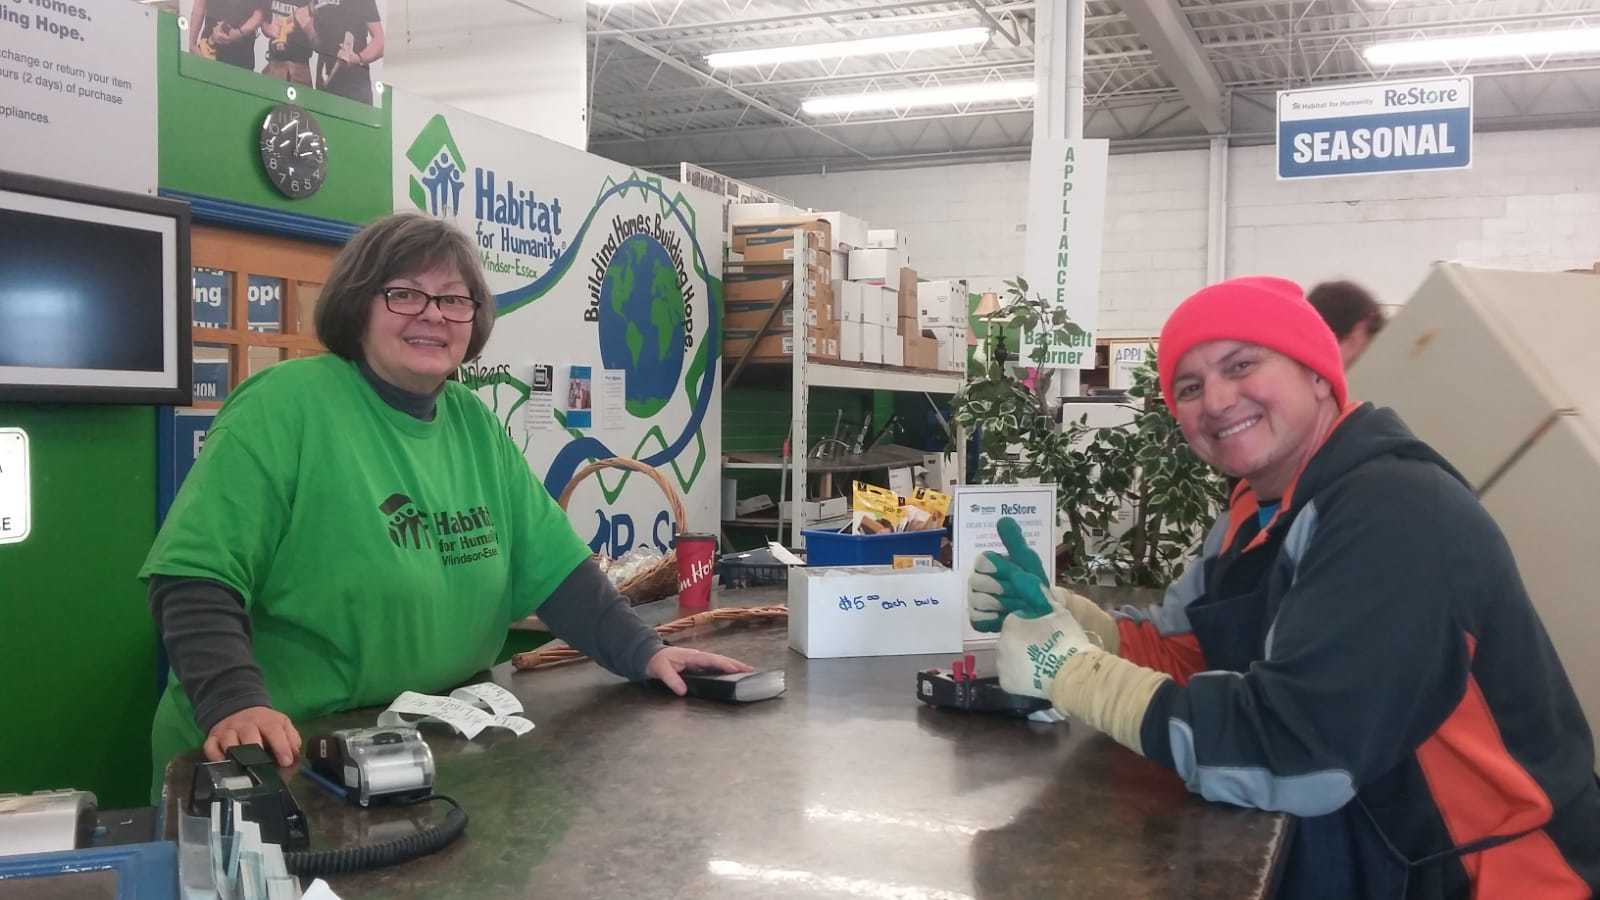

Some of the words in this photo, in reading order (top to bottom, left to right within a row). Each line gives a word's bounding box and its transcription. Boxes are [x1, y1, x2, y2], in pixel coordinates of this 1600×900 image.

[0, 4, 30, 29] ing
[36, 14, 85, 42] Hope.
[0, 48, 40, 68] change
[42, 60, 54, 72] or
[56, 61, 85, 79] return
[87, 70, 110, 84] your
[112, 76, 132, 91] item
[35, 74, 63, 93] days)
[66, 82, 76, 94] of
[78, 86, 123, 105] purchase
[1384, 87, 1458, 107] ReStore
[1293, 122, 1456, 164] SEASONAL
[475, 167, 562, 236] Habitat
[476, 221, 495, 249] for
[1056, 147, 1075, 310] APPLIANCE
[584, 233, 617, 322] Building
[1001, 503, 1037, 516] ReStore
